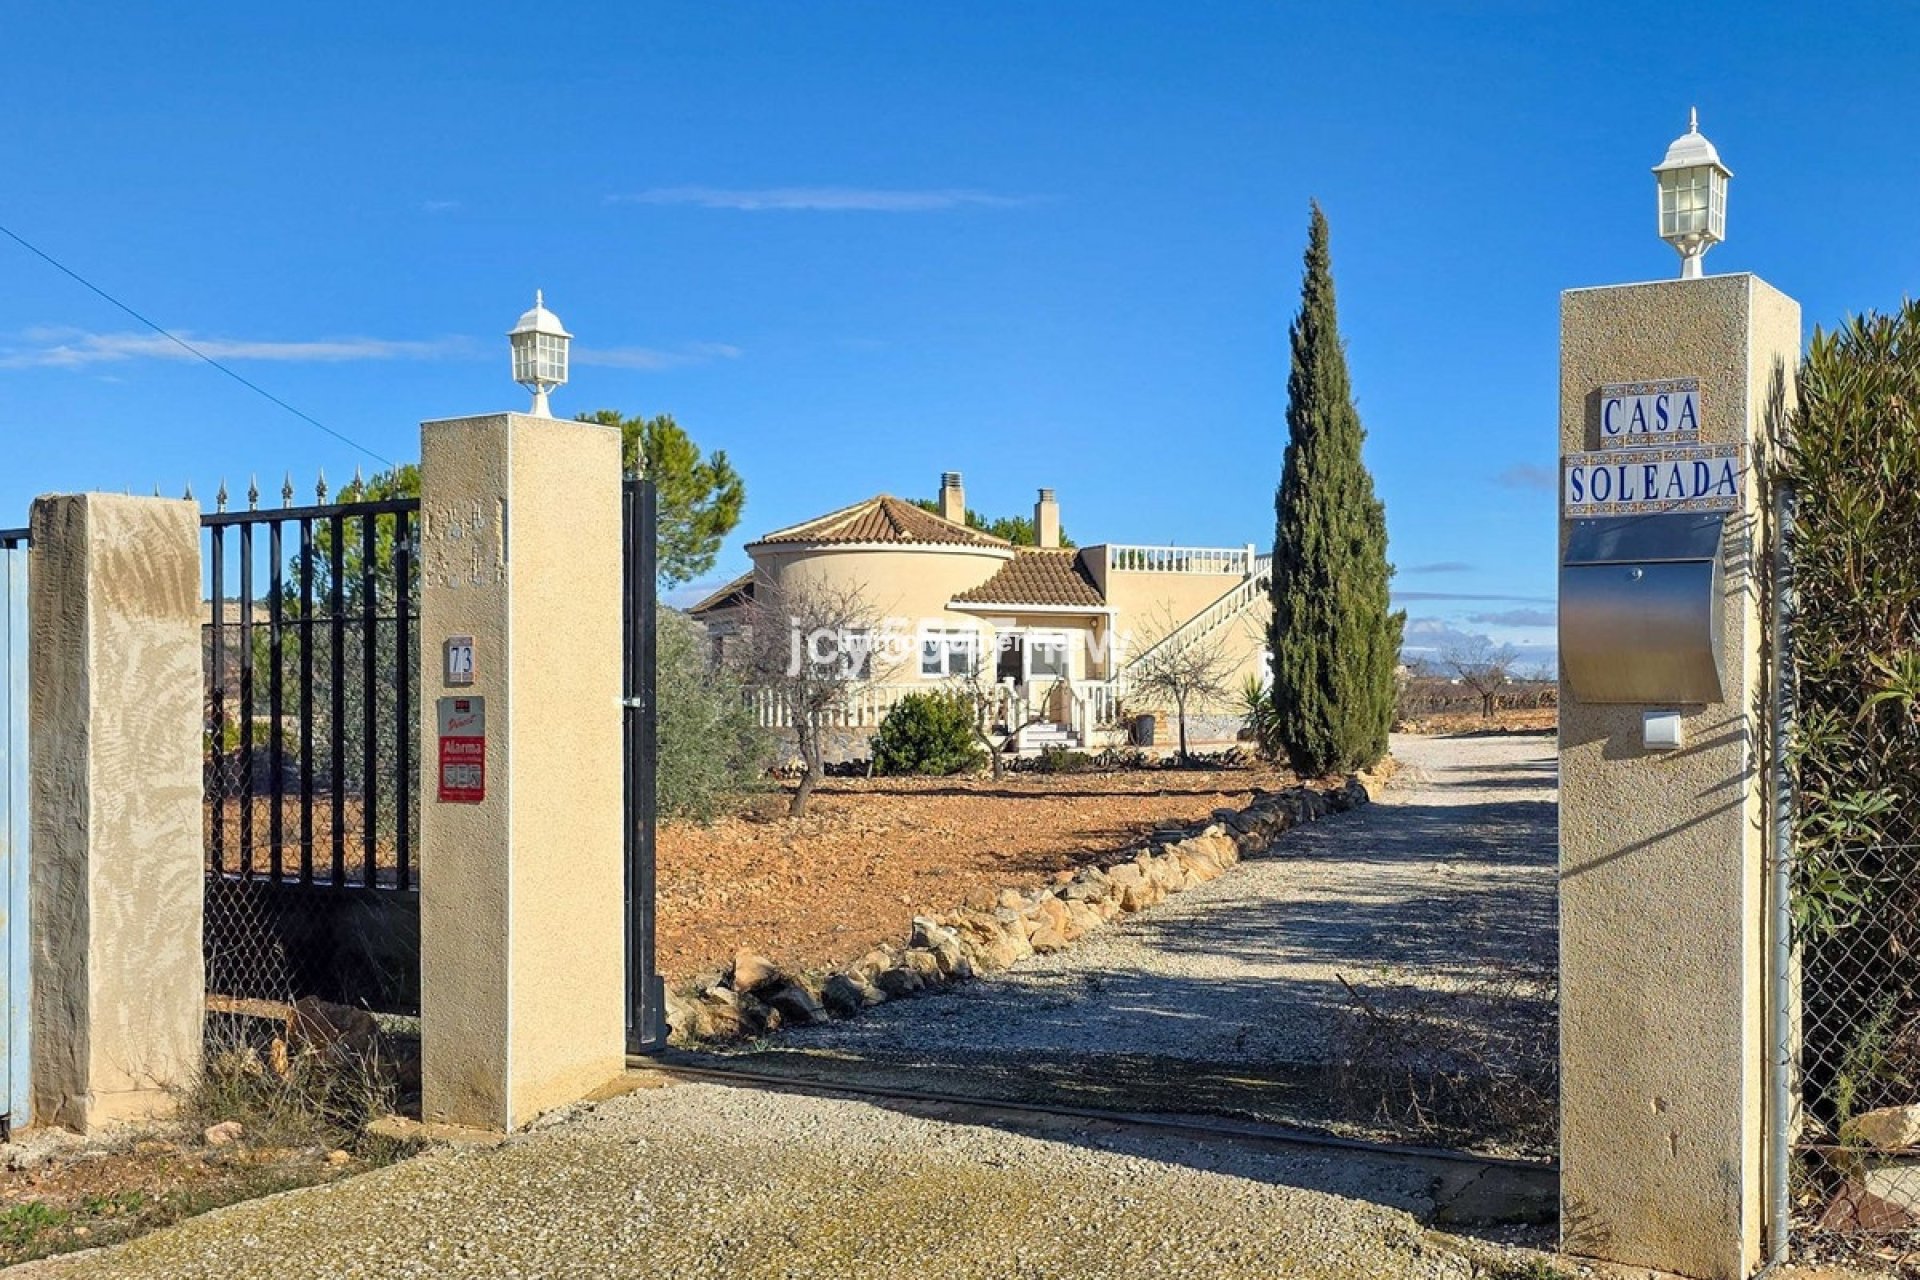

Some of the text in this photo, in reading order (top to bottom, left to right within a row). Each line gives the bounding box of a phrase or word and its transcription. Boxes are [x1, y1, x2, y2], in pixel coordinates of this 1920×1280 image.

[1604, 393, 1698, 435] CASA
[1571, 459, 1738, 503] SOLEADA
[450, 647, 472, 673] 73
[444, 740, 481, 754] Alarma
